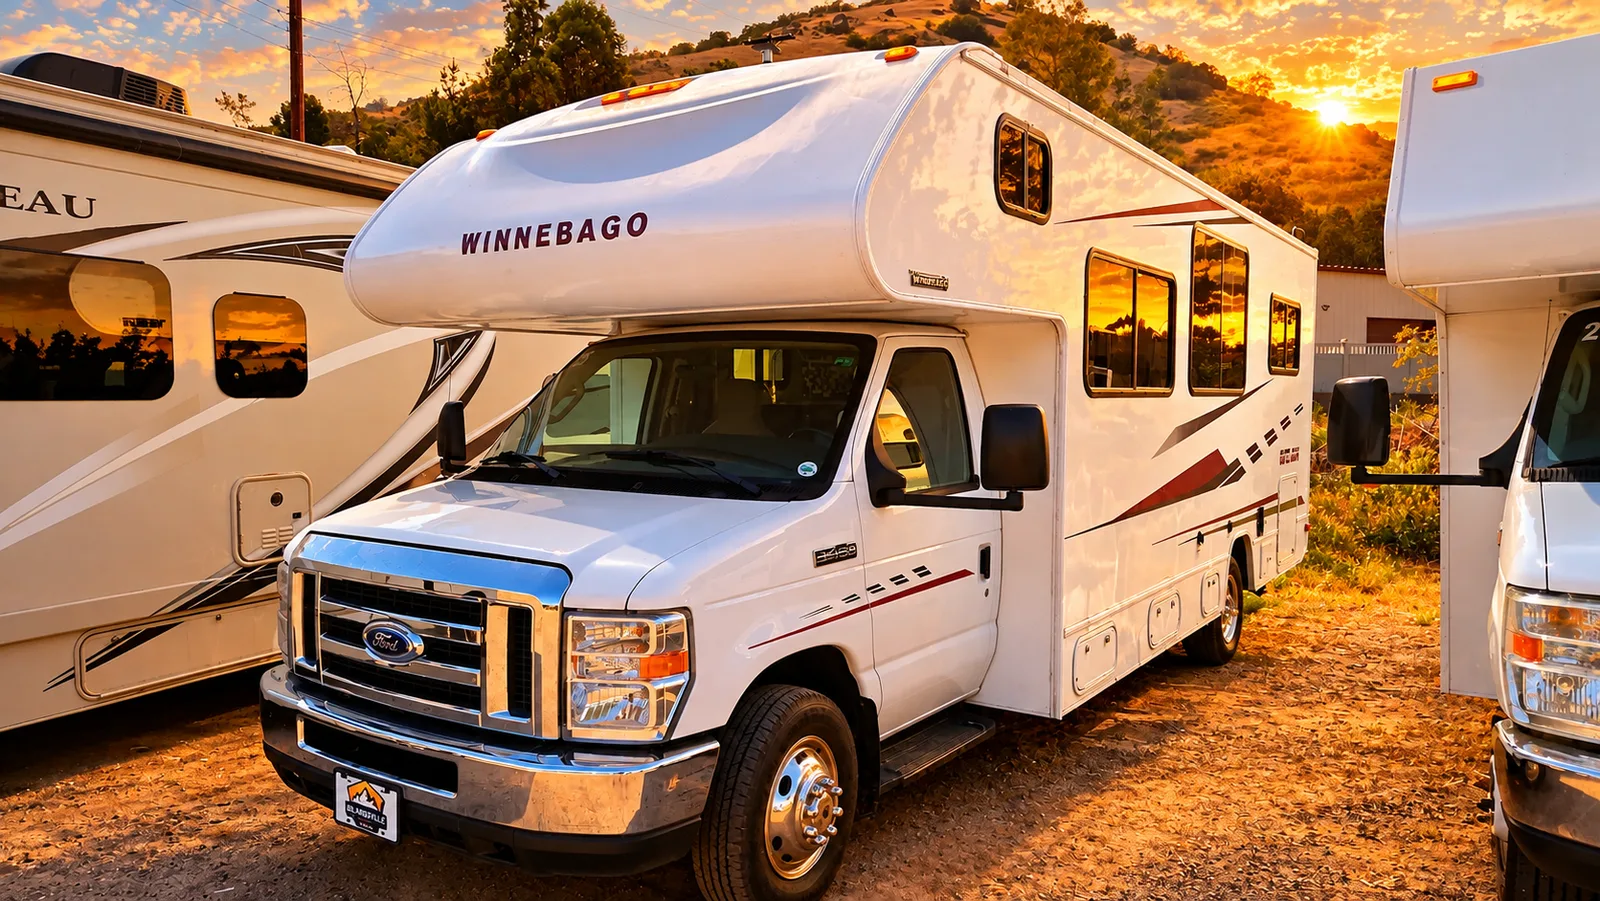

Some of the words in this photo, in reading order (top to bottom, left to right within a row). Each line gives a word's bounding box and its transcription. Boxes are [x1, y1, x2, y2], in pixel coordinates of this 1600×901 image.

[0, 184, 96, 219] EAU
[461, 211, 648, 255] WINNEBAGO
[372, 632, 399, 652] Ford
